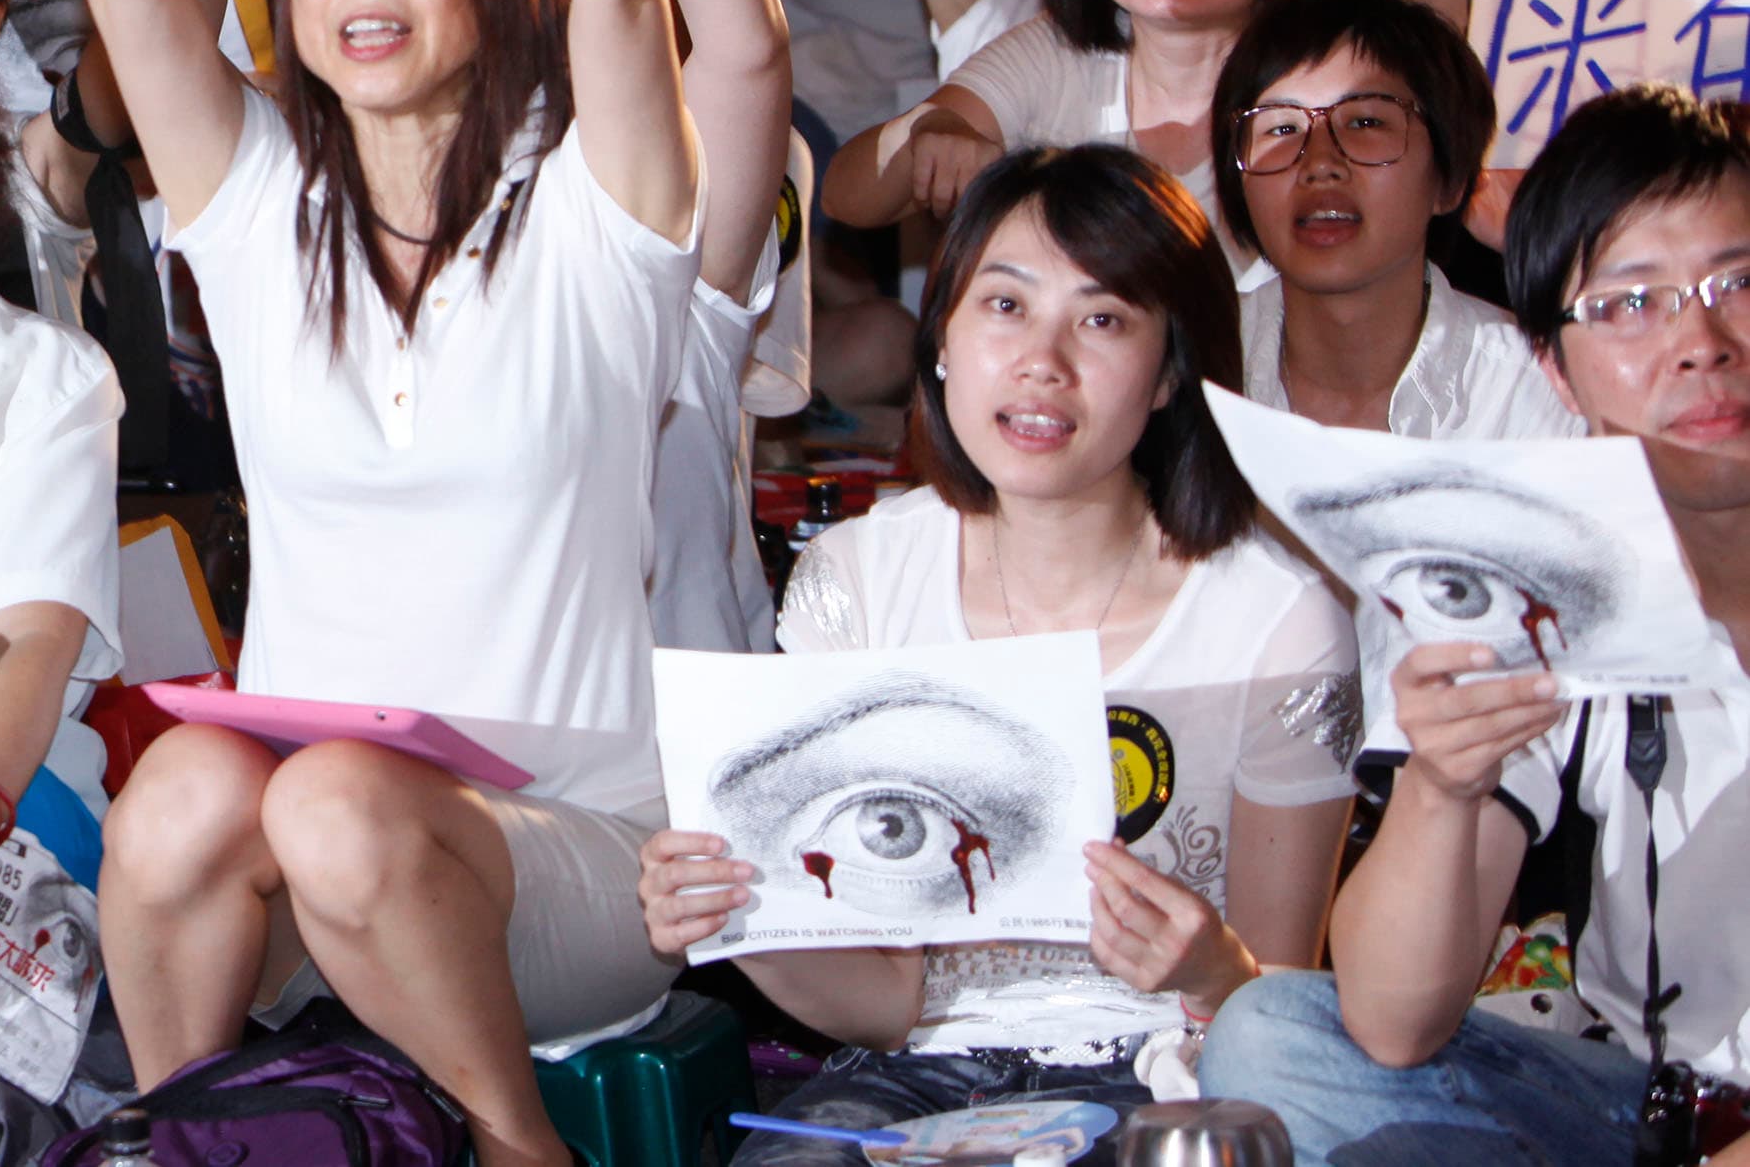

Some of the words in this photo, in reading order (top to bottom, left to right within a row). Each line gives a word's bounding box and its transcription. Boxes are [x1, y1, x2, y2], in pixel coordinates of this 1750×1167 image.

[721, 932, 745, 944] BIG
[749, 929, 800, 941] CITIZEN
[802, 928, 813, 938] IS
[815, 927, 884, 938] WATCHING
[887, 926, 913, 936] YOU
